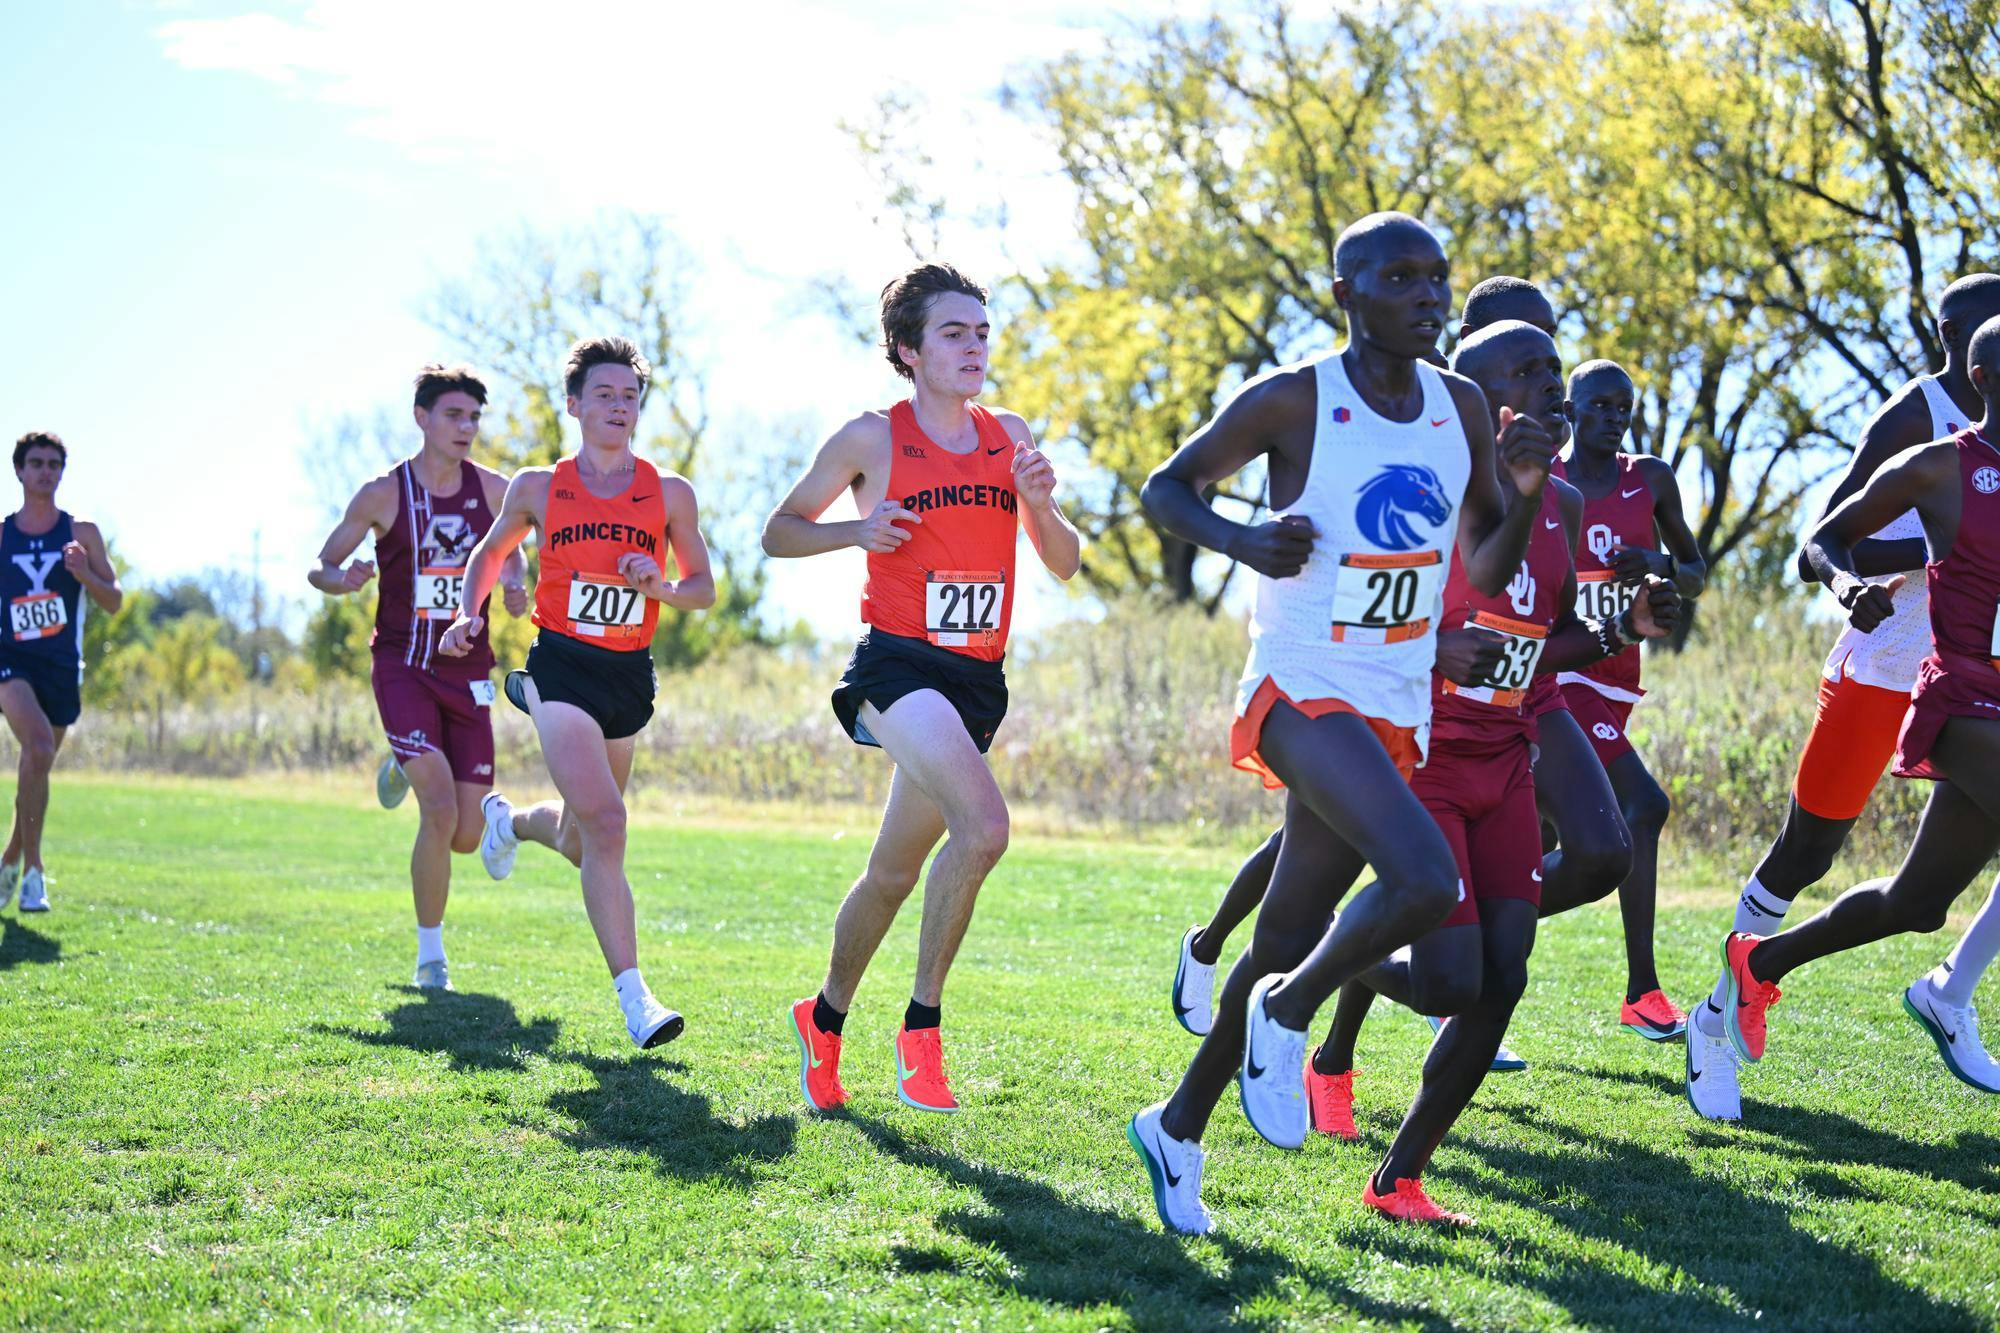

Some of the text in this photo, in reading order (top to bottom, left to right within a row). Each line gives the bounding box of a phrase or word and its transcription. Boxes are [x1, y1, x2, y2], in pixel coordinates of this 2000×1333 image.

[1974, 468, 1998, 491] SEC
[903, 484, 1017, 515] PRINCETON
[551, 522, 656, 554] PRINCETON
[12, 551, 62, 597] Y
[17, 598, 60, 631] 366
[579, 584, 638, 623] 207
[940, 584, 996, 628] 212
[1362, 569, 1418, 623] 20
[1579, 581, 1634, 620] 166
[1491, 636, 1538, 688] 63
[1593, 722, 1618, 740] OU
